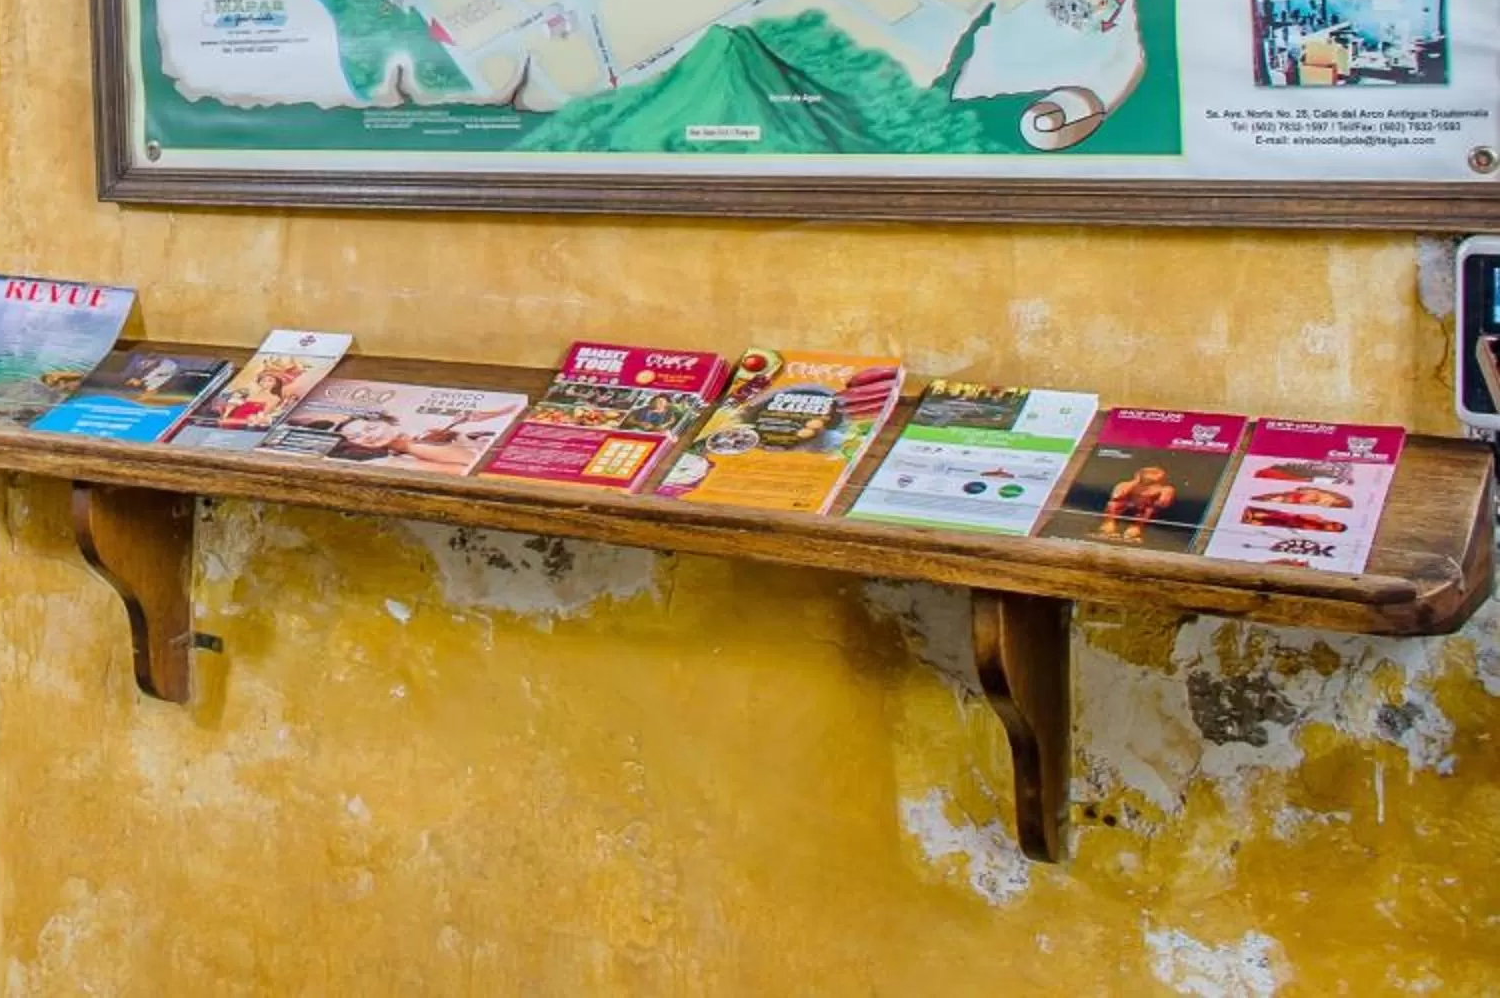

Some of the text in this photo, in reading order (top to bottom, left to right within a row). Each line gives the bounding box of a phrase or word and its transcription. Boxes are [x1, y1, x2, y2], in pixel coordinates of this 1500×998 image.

[1312, 109, 1338, 119] Calle
[1341, 109, 1357, 119] del
[1359, 109, 1385, 119] Arco
[1387, 109, 1428, 121] Antigua
[1430, 108, 1489, 119] Guatemala
[1255, 134, 1290, 145] E-mail:
[3, 280, 109, 308] REVUE
